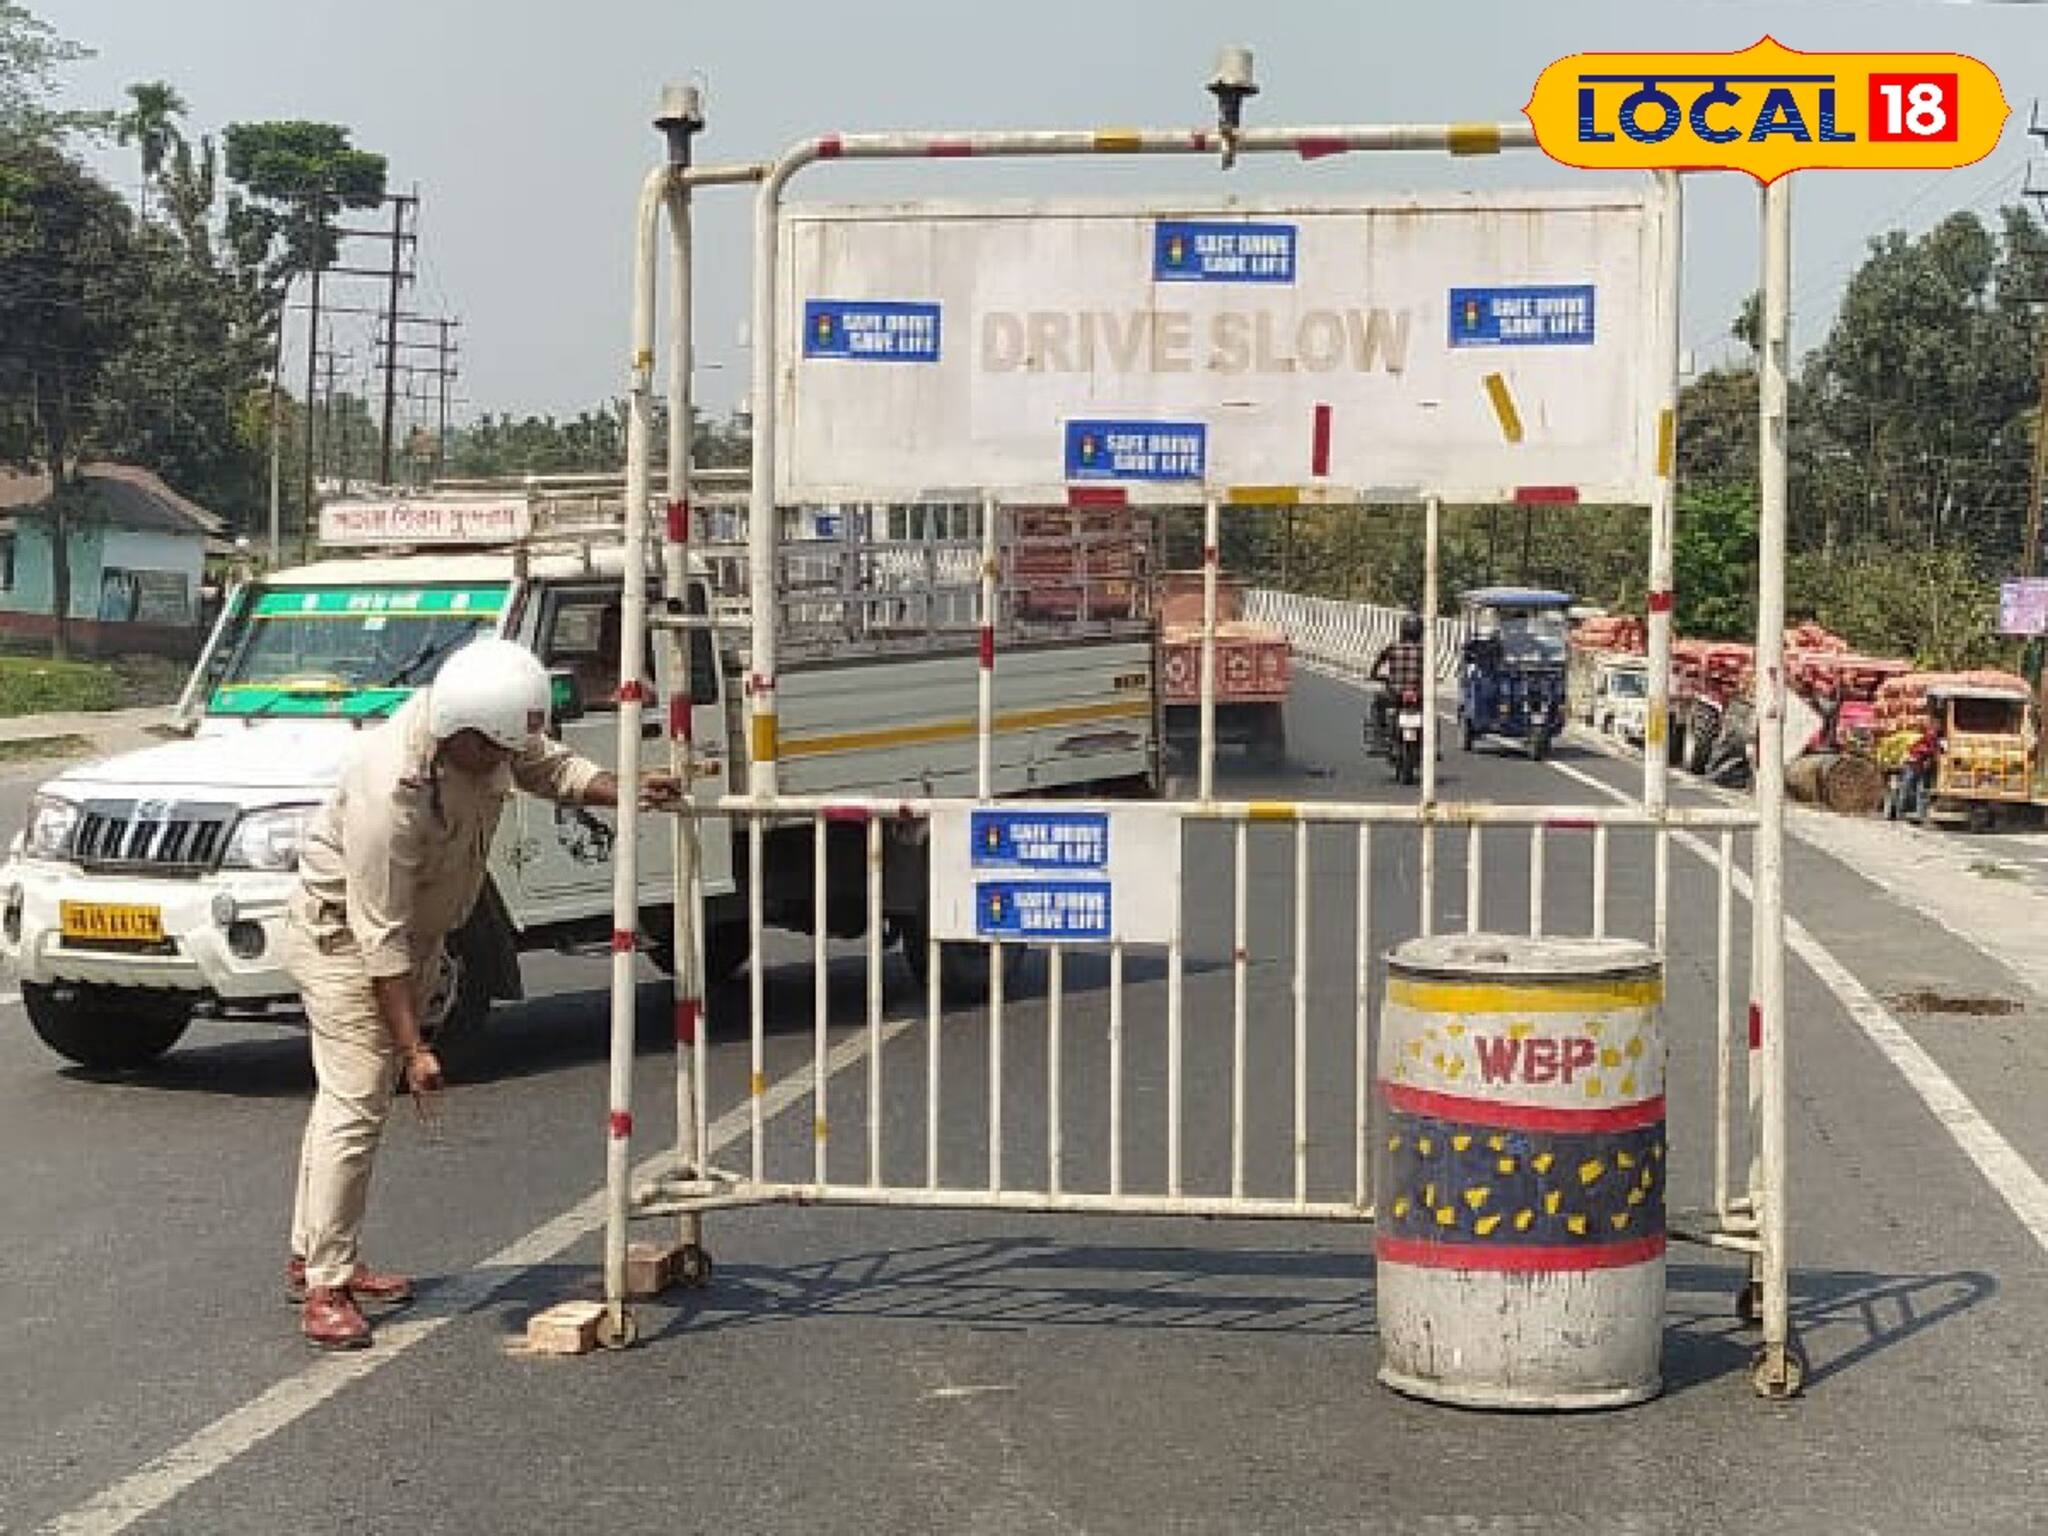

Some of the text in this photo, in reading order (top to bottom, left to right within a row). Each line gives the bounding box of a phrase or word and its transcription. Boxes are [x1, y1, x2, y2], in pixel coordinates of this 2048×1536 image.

[982, 308, 1411, 374] DRIVE SLOW
[1474, 1035, 1596, 1084] WBP
